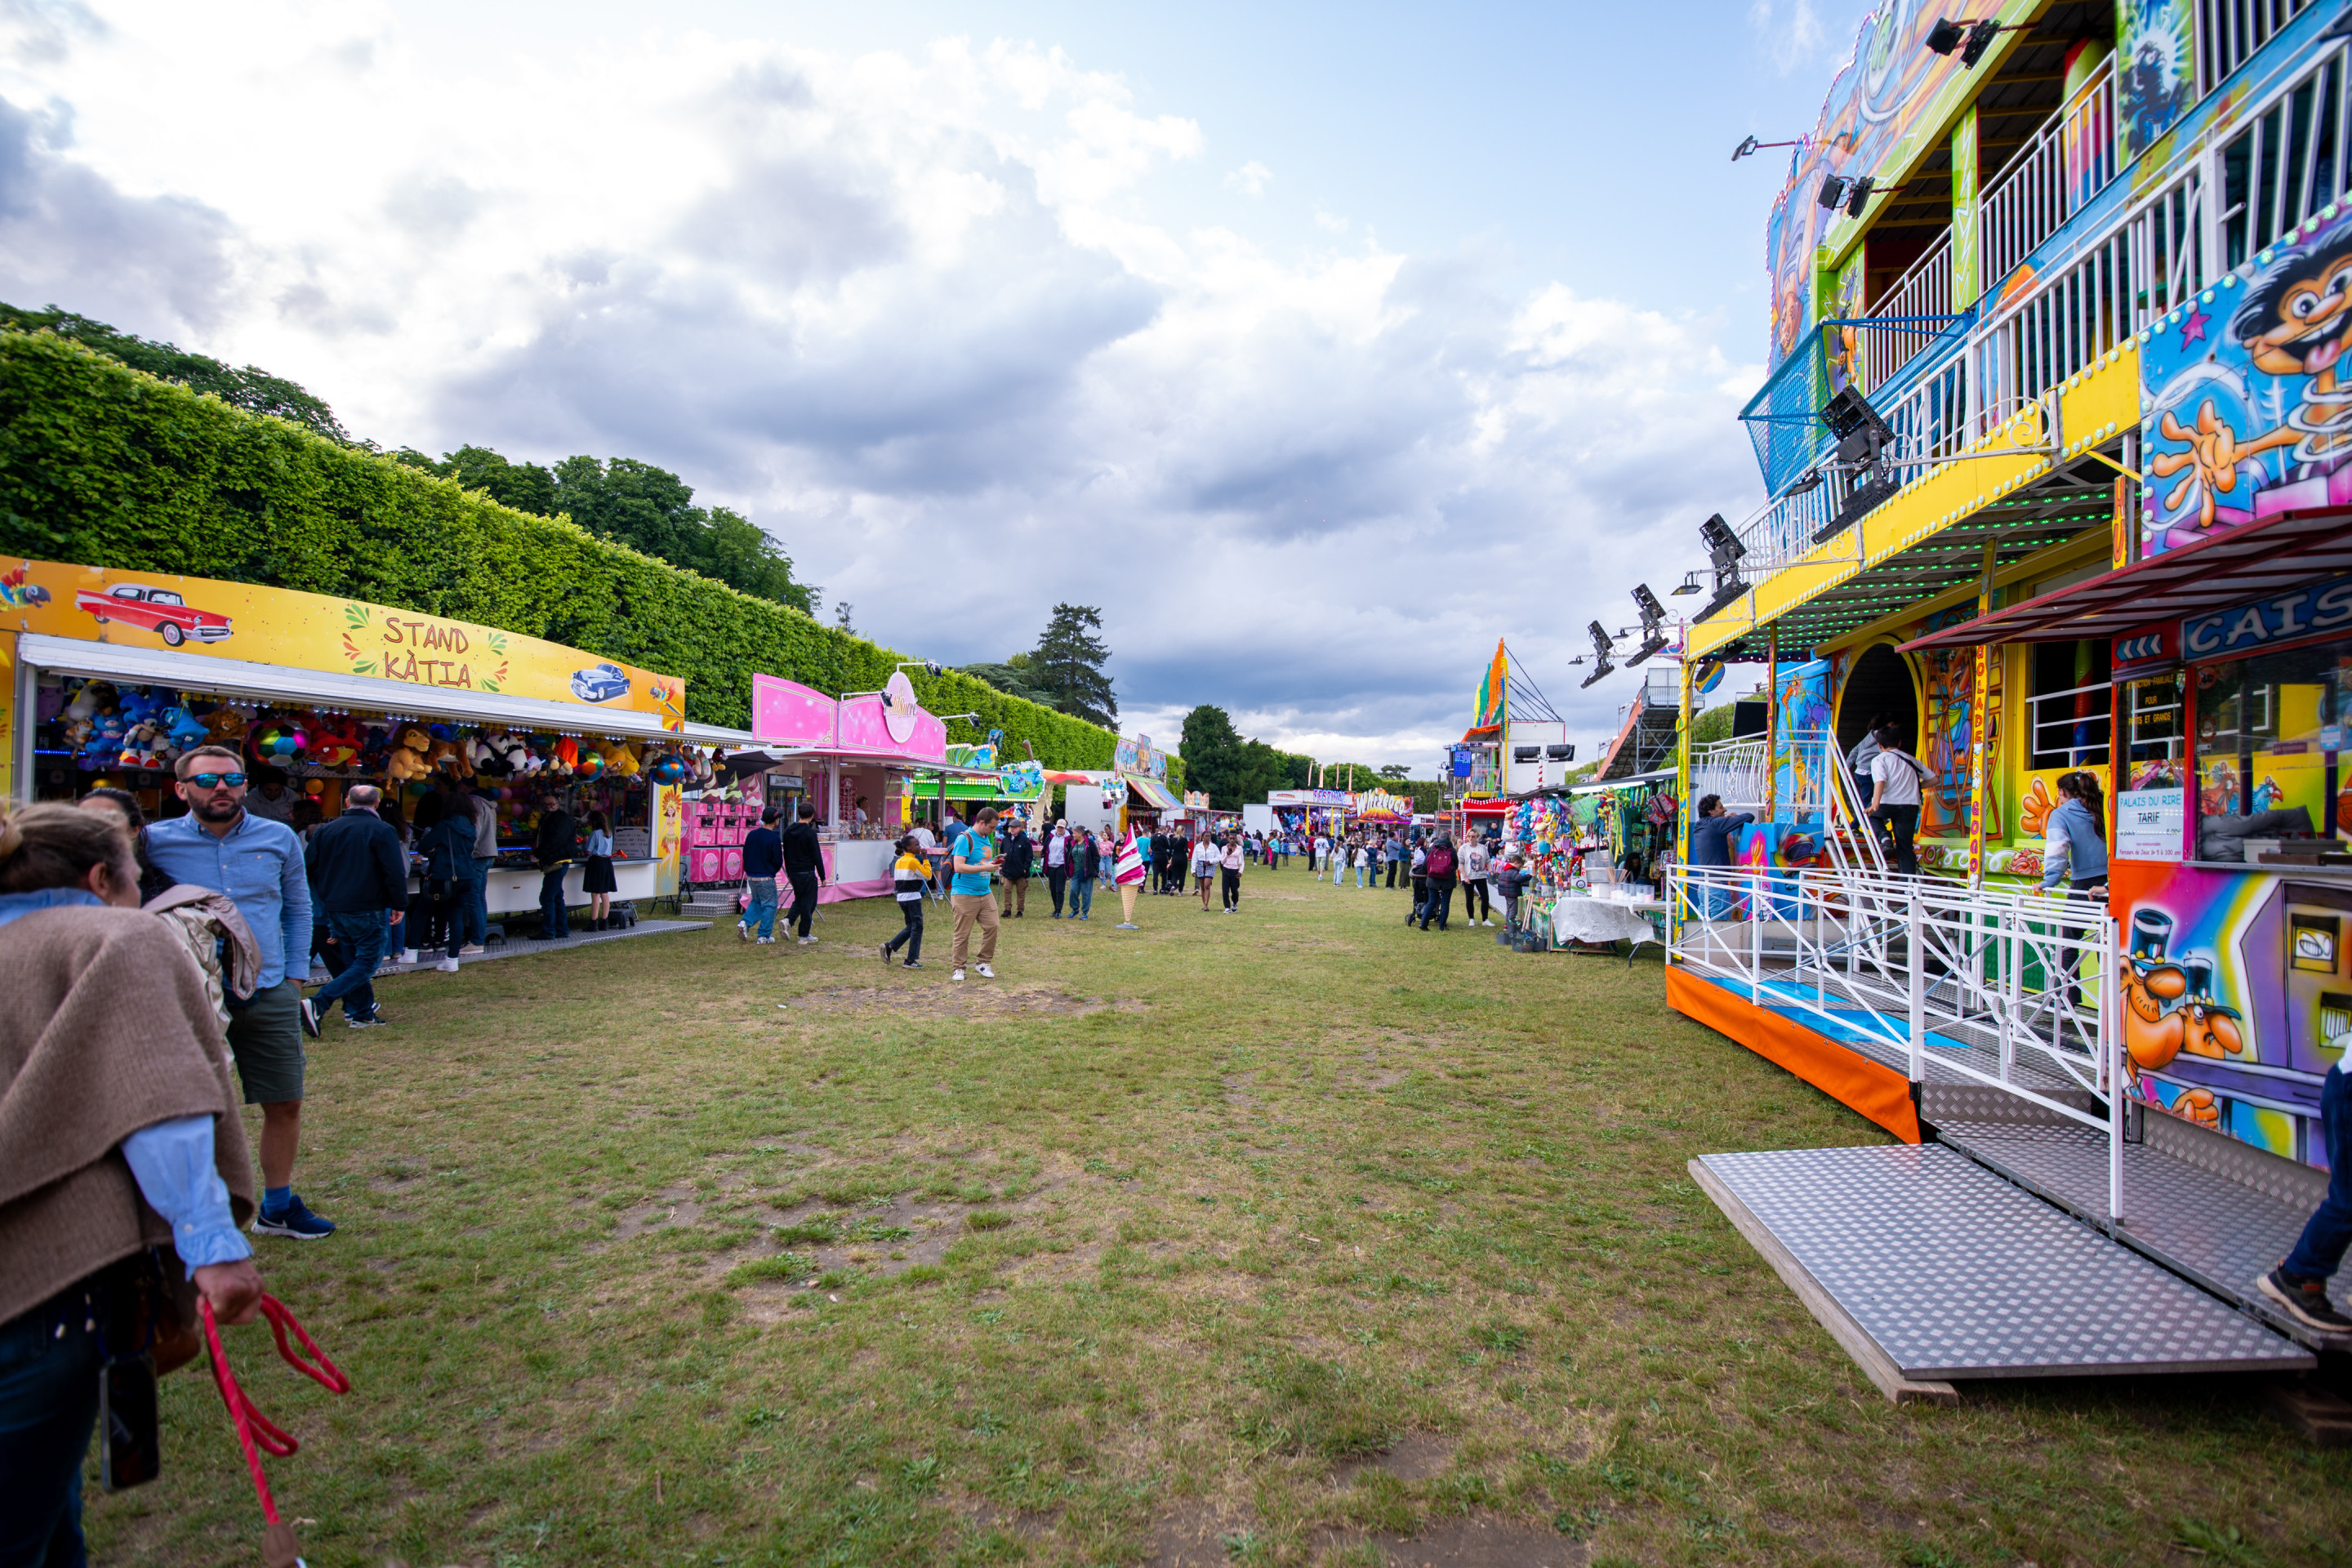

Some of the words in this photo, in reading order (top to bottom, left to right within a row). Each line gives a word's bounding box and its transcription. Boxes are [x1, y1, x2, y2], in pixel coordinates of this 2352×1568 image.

[2189, 582, 2352, 653] CAIS
[384, 617, 469, 653] STAND
[385, 649, 471, 688] KÀTIA
[1974, 608, 1986, 743] RGOLADE
[2153, 674, 2174, 686] FAMILIALE
[2145, 695, 2158, 705] POUR
[2145, 715, 2150, 724] ET
[2153, 711, 2172, 723] GRANDS
[2120, 796, 2146, 808] PALAIS
[2149, 795, 2159, 806] DU
[2162, 794, 2181, 805] RIRE
[1678, 797, 1686, 849] MORT
[2137, 812, 2160, 823] TARIF
